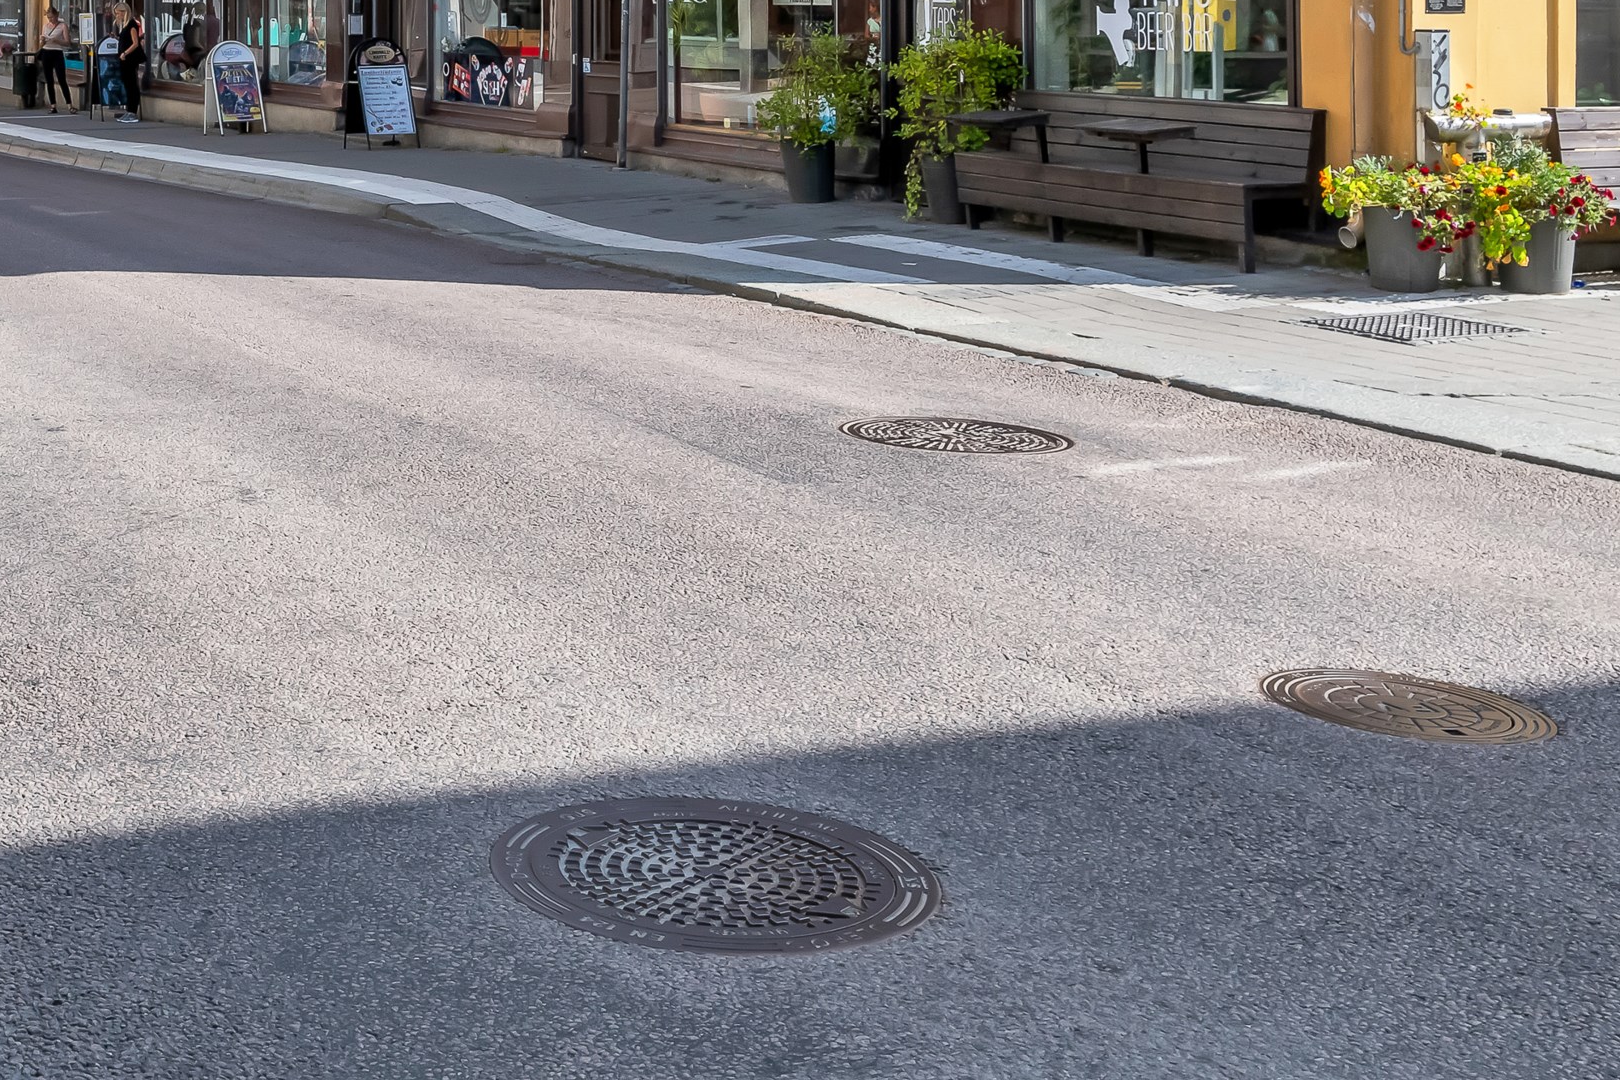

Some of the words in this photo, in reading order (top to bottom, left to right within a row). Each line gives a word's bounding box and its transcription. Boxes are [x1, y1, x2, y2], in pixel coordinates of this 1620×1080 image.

[932, 6, 957, 38] TAPS
[1137, 11, 1174, 52] BEER
[1182, 12, 1213, 53] BAR
